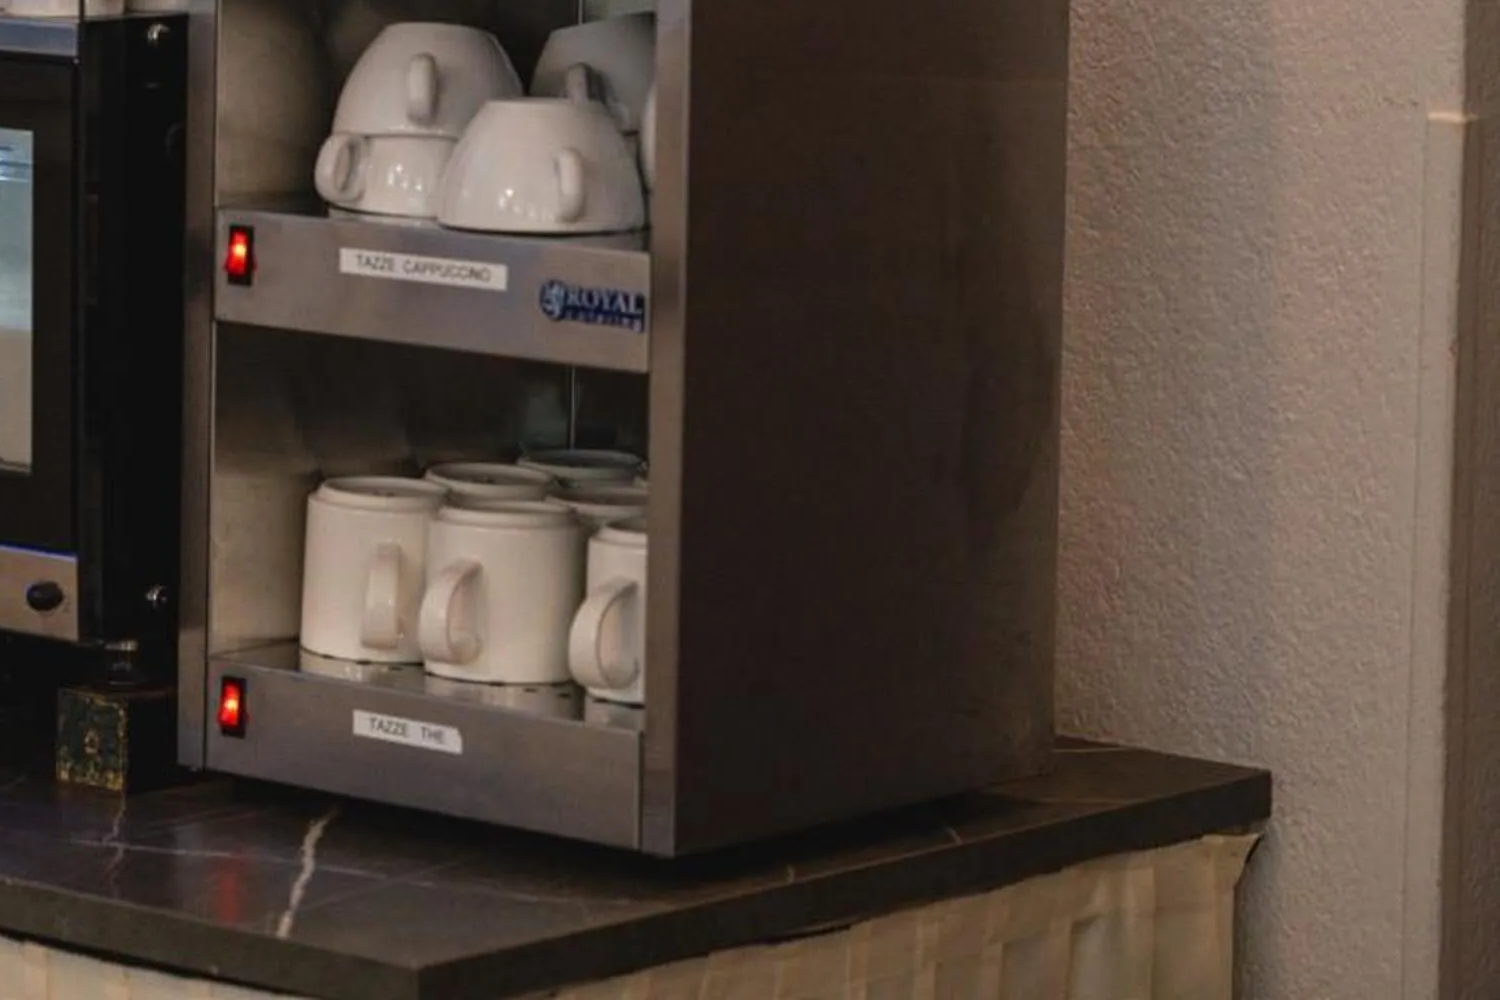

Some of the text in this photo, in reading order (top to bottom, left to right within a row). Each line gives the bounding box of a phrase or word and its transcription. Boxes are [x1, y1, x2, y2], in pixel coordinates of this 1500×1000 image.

[356, 253, 492, 283] TAZZE CAPPUCCINO
[370, 716, 448, 745] TAZZE THE
